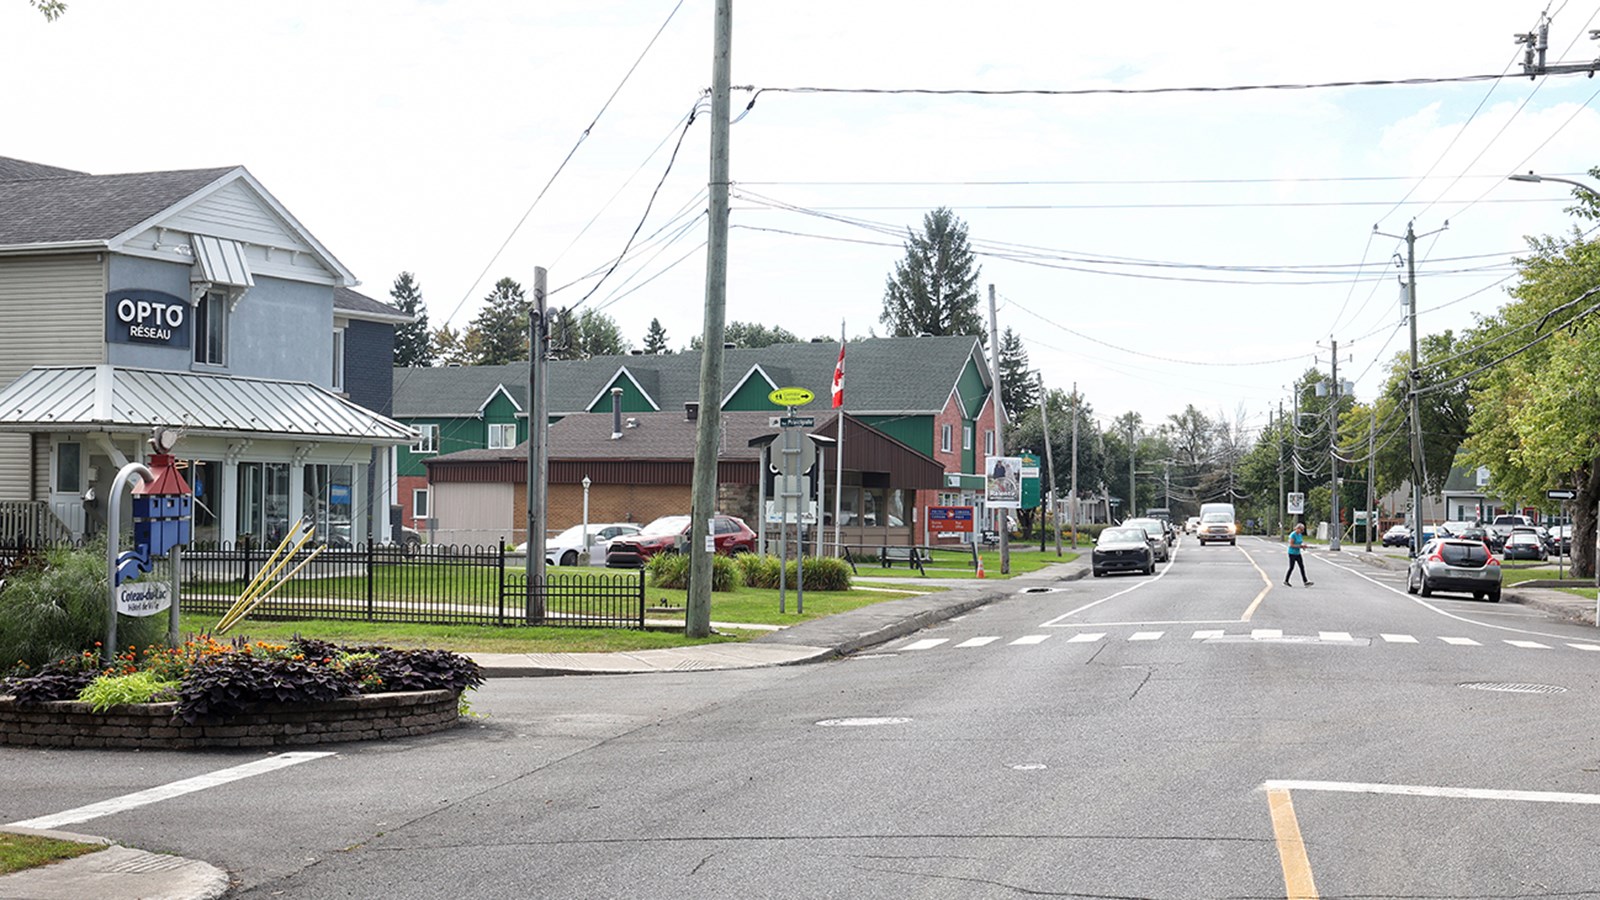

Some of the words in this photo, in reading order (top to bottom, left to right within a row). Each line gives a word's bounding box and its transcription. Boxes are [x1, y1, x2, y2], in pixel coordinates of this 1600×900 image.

[117, 298, 184, 328] OPTO
[130, 324, 171, 340] RÉSEAU
[121, 588, 167, 603] Coteau-du-Lac
